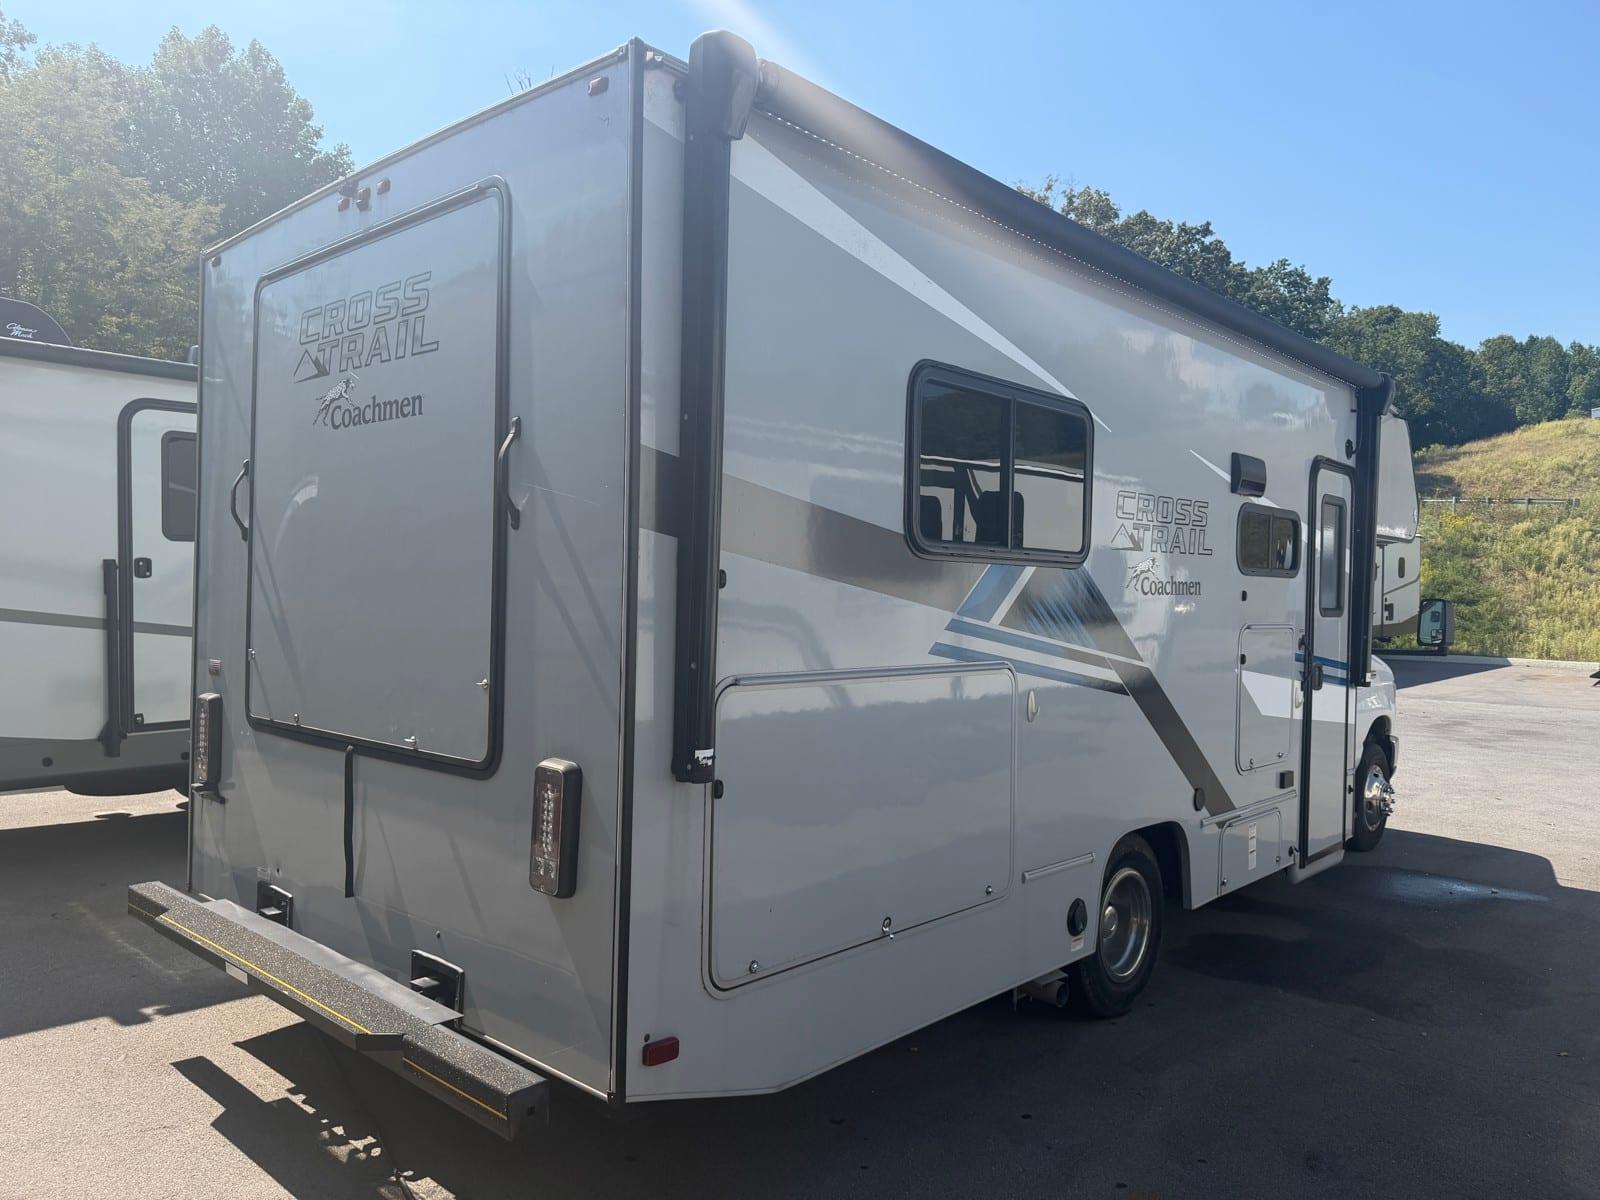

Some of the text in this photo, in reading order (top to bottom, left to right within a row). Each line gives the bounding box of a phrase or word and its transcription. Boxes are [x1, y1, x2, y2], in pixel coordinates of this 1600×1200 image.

[300, 271, 432, 345] CROSS
[318, 315, 440, 376] TRAIL
[331, 393, 424, 430] Coachmen
[1116, 490, 1209, 528] CROSS
[1132, 522, 1213, 556] TRAIL
[1140, 575, 1201, 596] Coachmen
